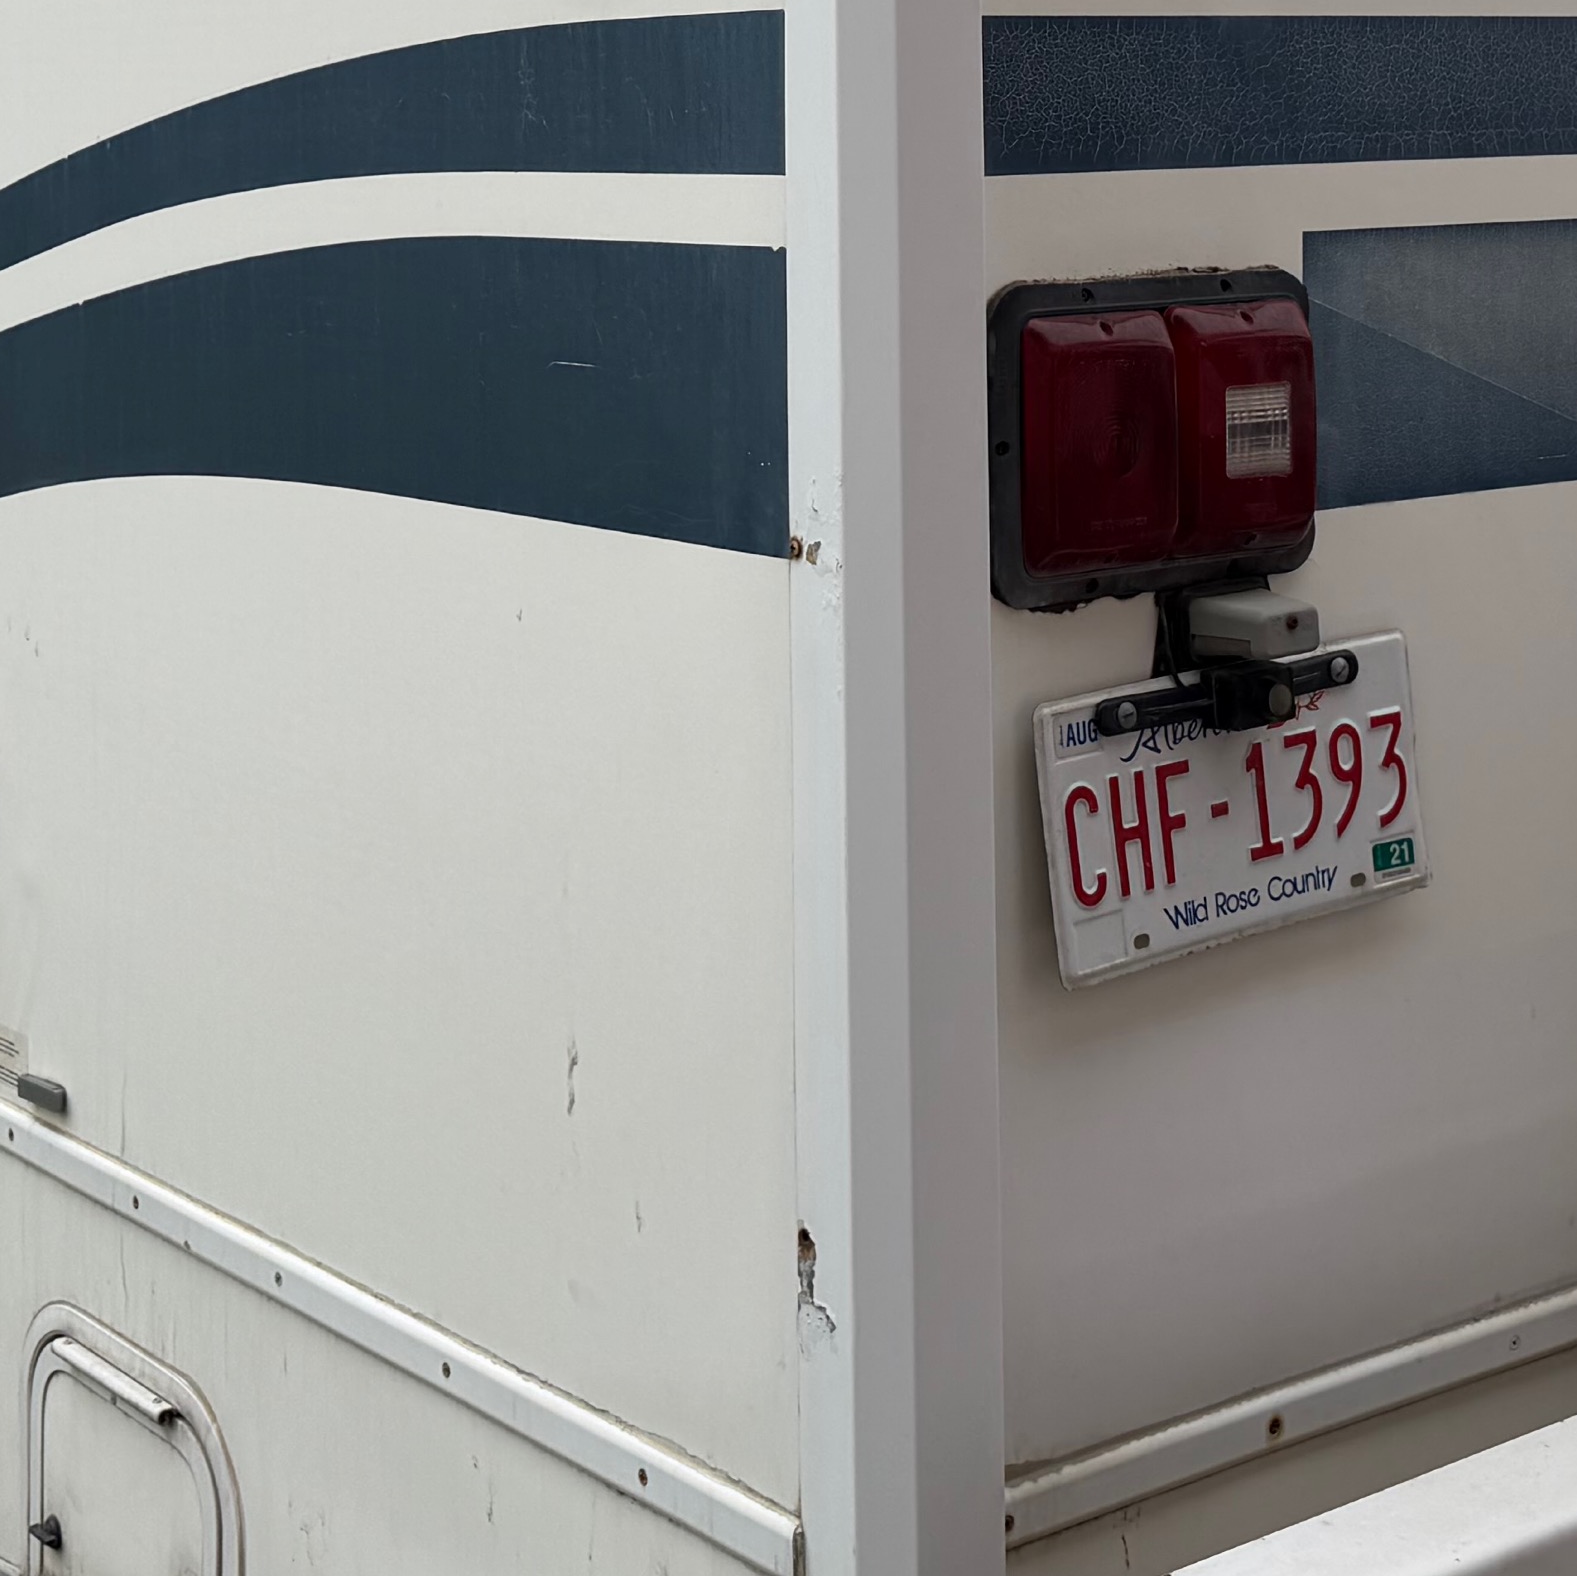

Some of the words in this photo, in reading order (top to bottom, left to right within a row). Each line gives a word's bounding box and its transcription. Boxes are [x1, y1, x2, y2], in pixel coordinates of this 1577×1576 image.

[1066, 722, 1098, 748] AUG
[1064, 710, 1408, 908] CHF-1393
[1390, 841, 1409, 865] 21
[1164, 896, 1209, 931] Wild
[1215, 888, 1262, 919] Rose
[1267, 865, 1338, 902] Country
